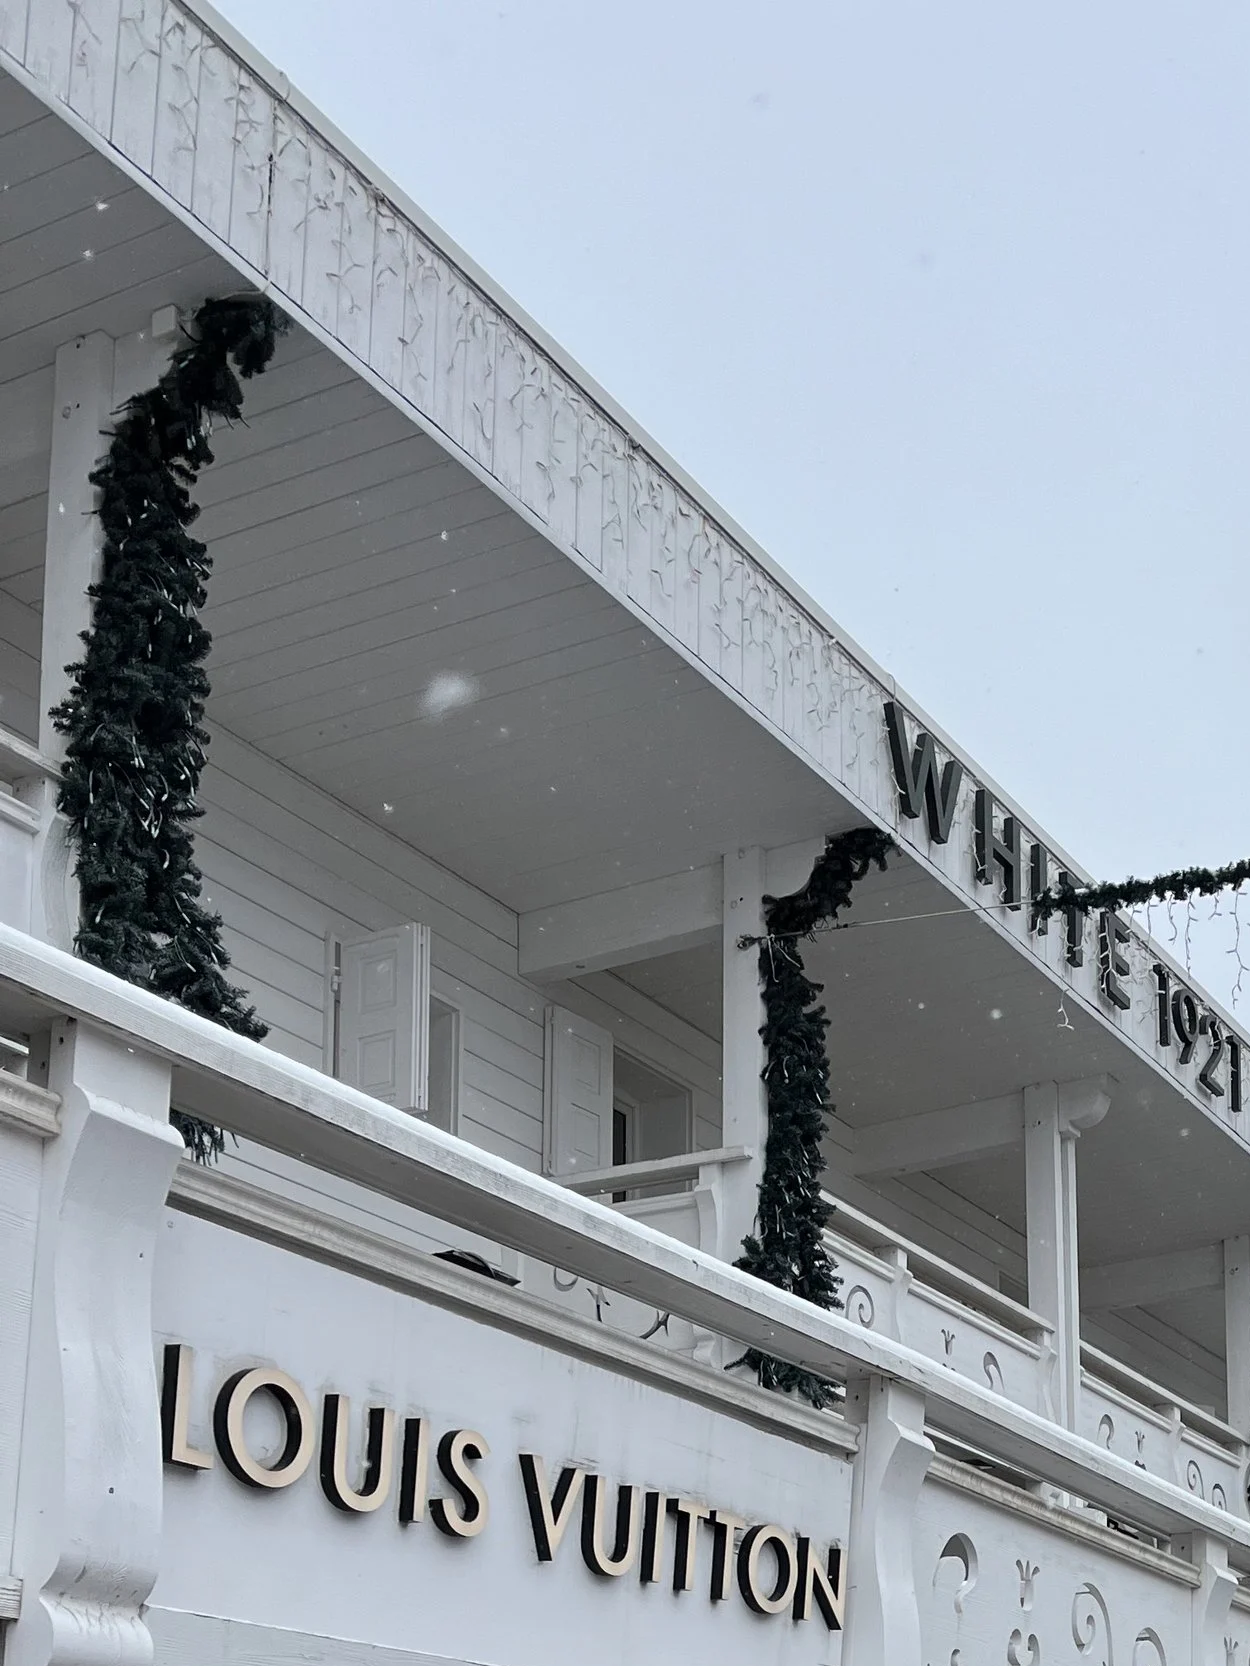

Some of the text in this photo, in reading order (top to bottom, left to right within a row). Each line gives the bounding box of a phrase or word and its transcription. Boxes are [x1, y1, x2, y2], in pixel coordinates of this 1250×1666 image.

[884, 702, 1242, 1113] WHITE 1921
[162, 1344, 847, 1631] LOUIS VUITTON
